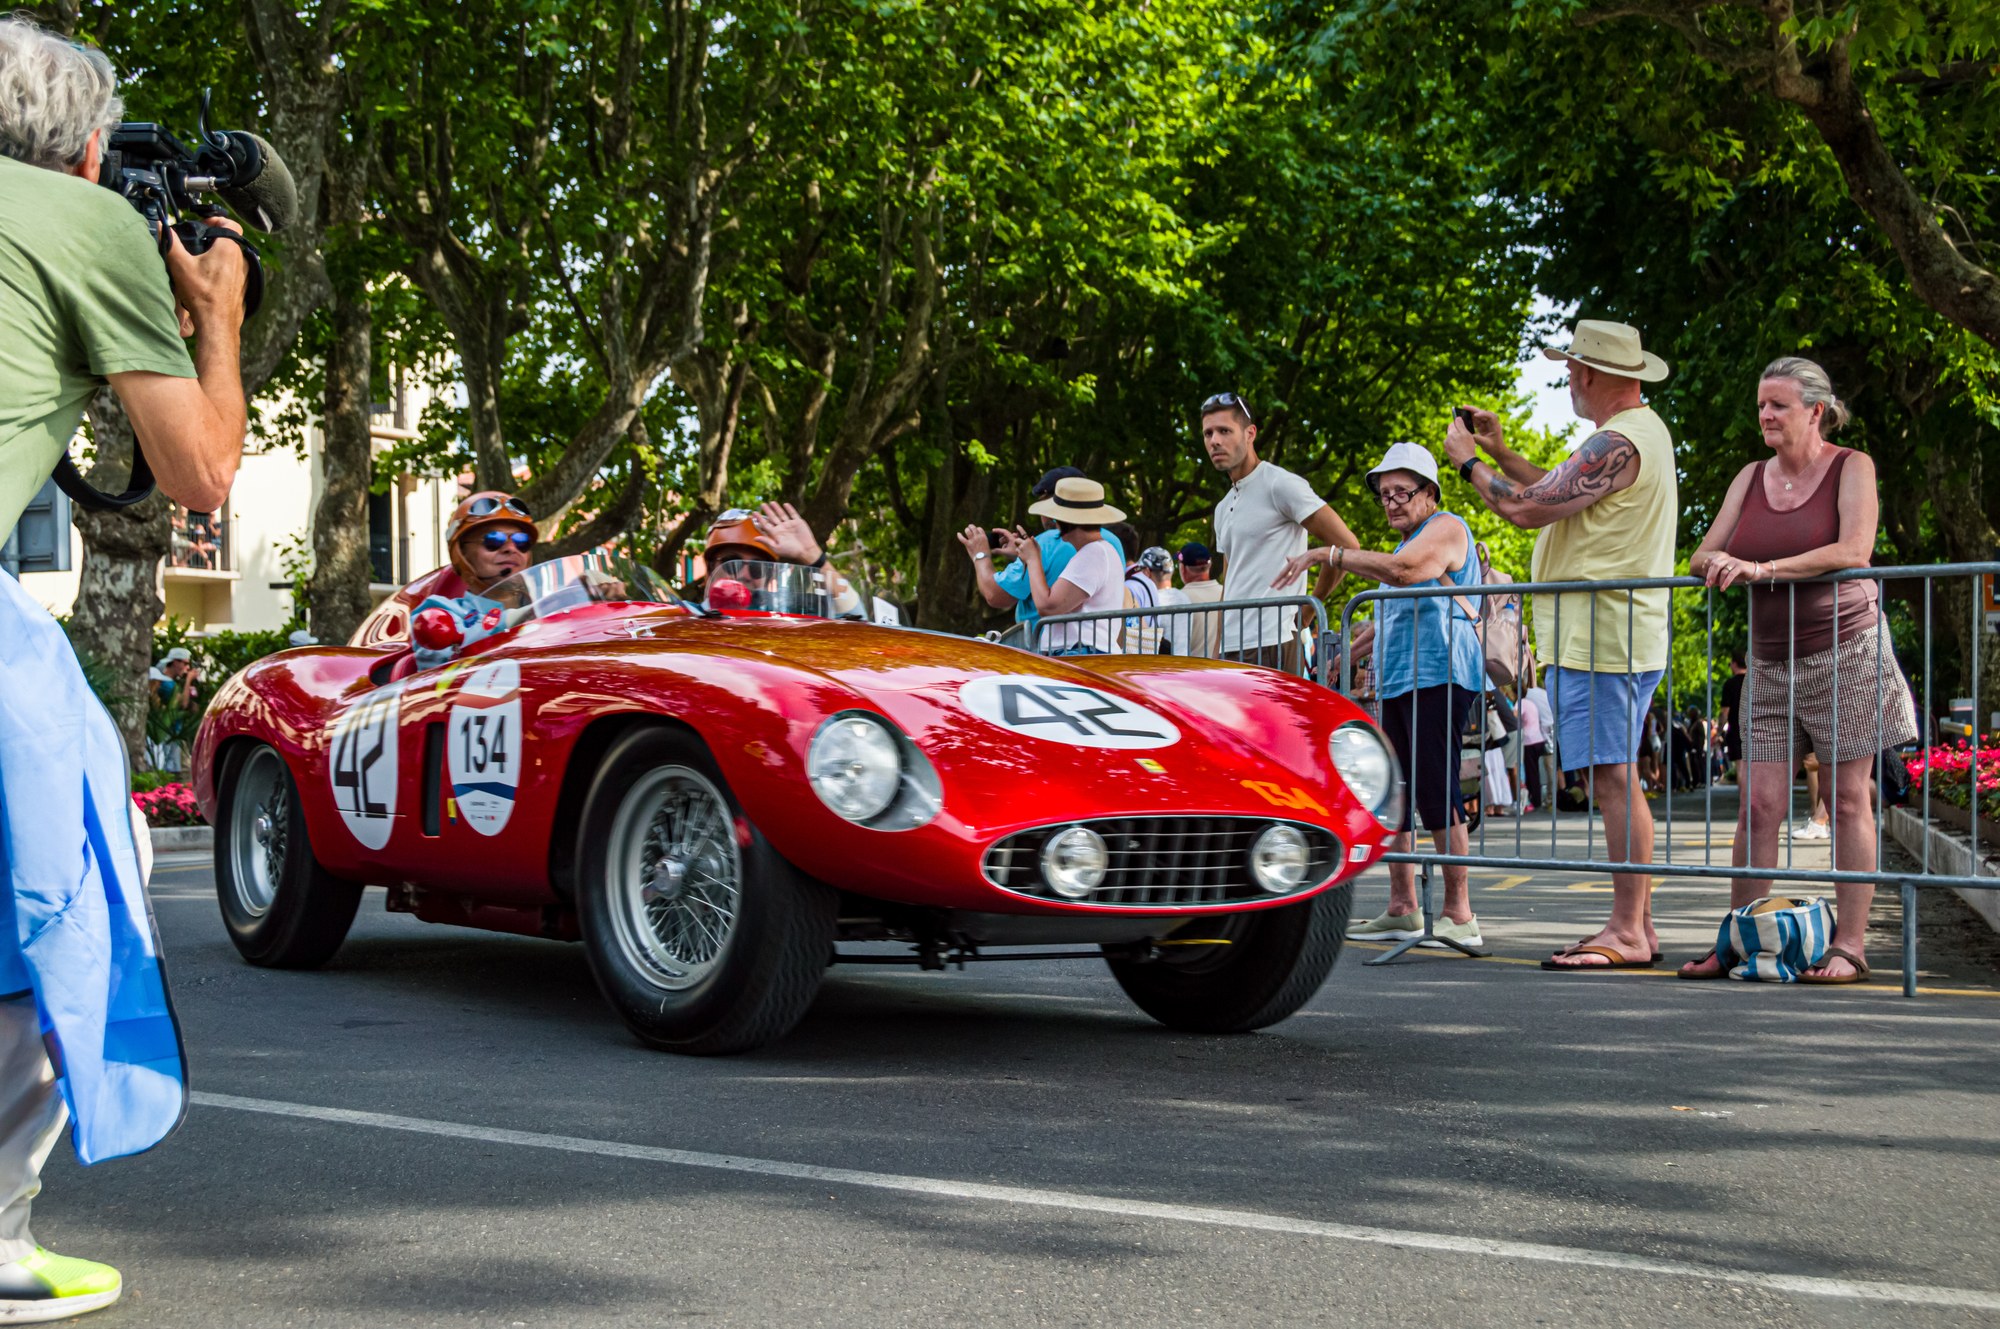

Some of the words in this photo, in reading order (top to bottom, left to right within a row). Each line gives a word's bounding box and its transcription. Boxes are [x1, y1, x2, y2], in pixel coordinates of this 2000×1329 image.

[998, 684, 1168, 739] 42
[334, 691, 397, 819] 42
[460, 714, 508, 773] 134
